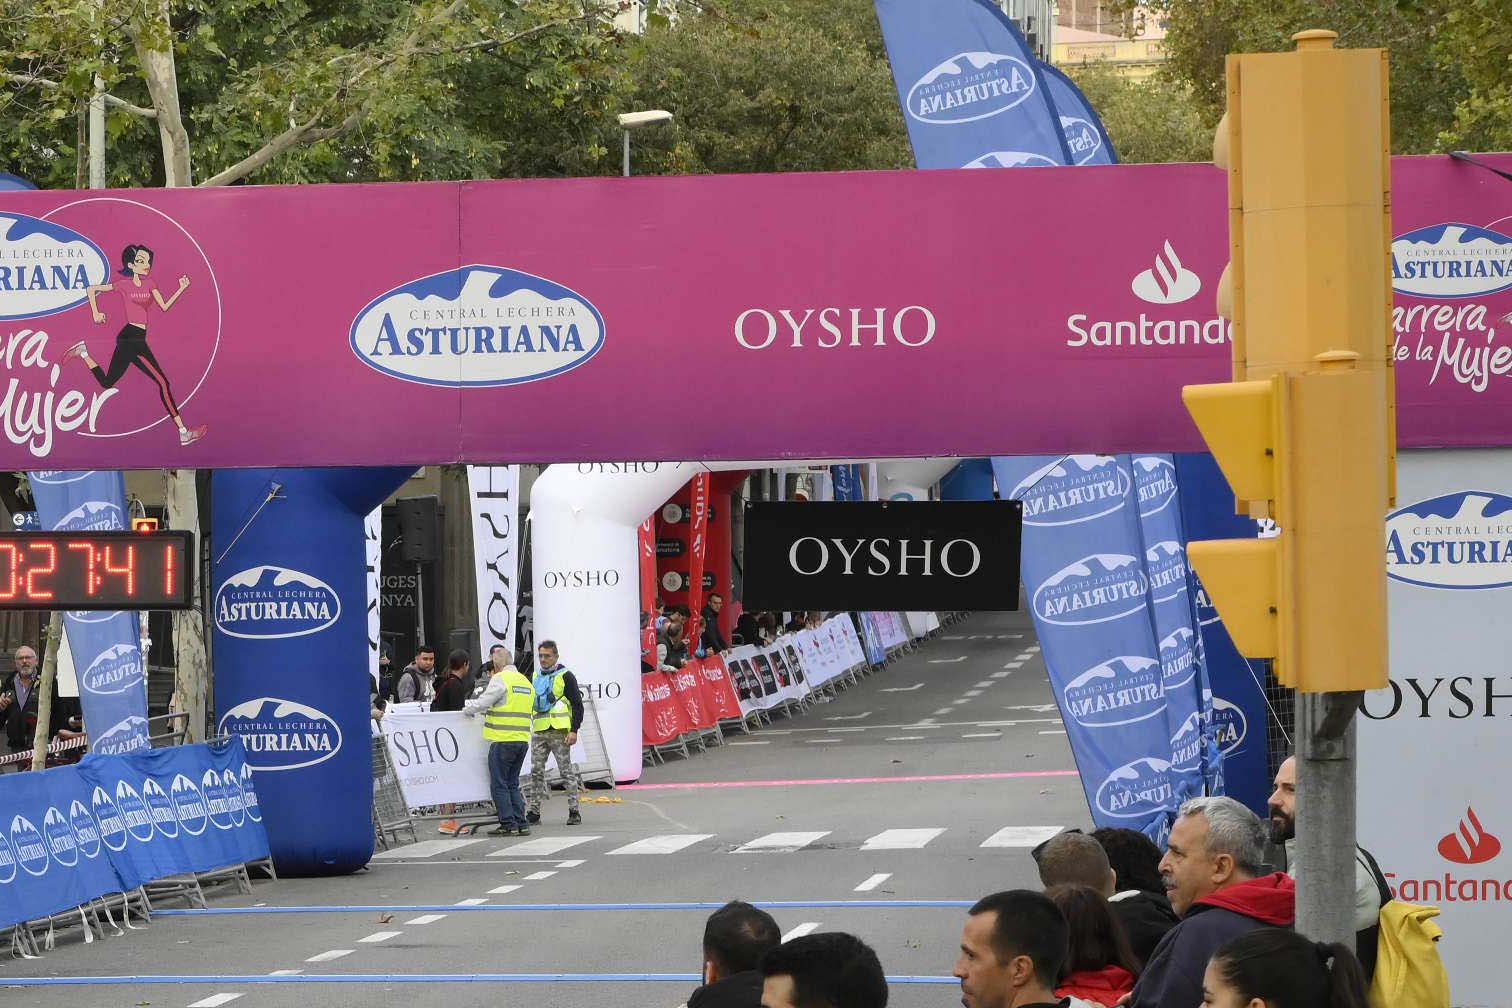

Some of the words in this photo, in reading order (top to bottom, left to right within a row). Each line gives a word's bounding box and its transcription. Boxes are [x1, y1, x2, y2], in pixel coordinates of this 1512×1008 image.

[13, 248, 85, 258] LECHERA
[1406, 249, 1457, 257] CENTRAL
[409, 308, 487, 320] CENTRAL
[496, 306, 576, 318] LECHERA
[369, 312, 585, 356] ASTURIANA
[734, 305, 936, 350] OYSHO
[1415, 333, 1433, 361] la
[1413, 526, 1480, 535] CENTRAL
[788, 536, 981, 578] OYSHO
[544, 569, 619, 589] OYSHO
[232, 591, 273, 599] CENTRAL
[279, 590, 327, 598] LECHERA
[219, 595, 331, 622] ASTURIANA
[233, 723, 274, 731] CENTRAL
[279, 722, 327, 730] LECHERA
